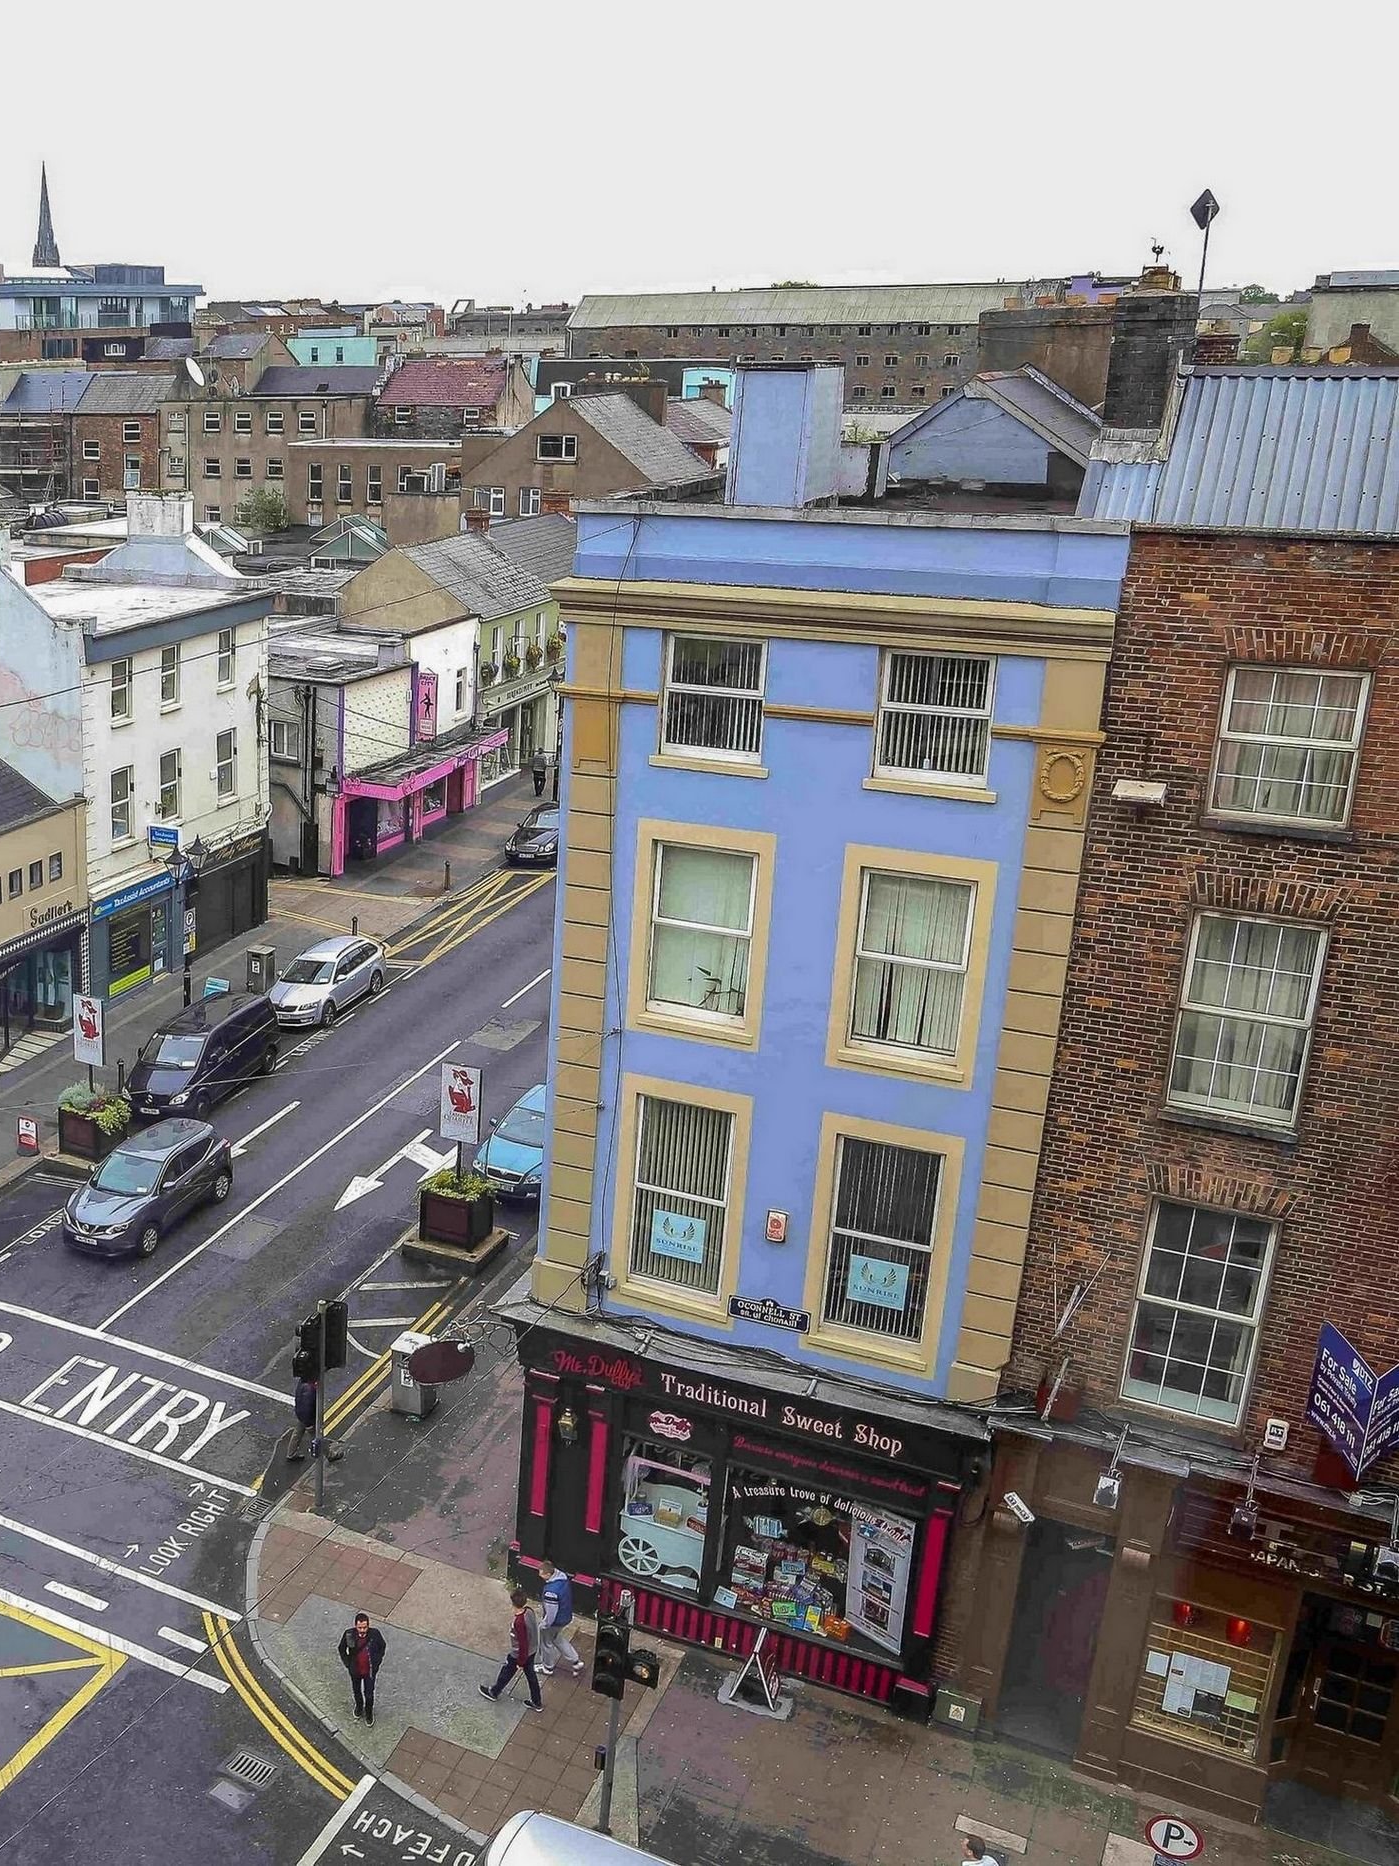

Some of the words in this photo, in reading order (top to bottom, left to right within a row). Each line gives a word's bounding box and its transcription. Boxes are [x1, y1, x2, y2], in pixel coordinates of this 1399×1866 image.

[656, 1238, 699, 1253] SUNRISE
[852, 1284, 901, 1300] SUNRISE
[1321, 1347, 1338, 1372] For
[1338, 1366, 1357, 1396] Sale
[18, 1354, 252, 1462] ENTRY
[660, 1372, 767, 1418] Traditional
[782, 1406, 843, 1439] Sweet
[853, 1423, 903, 1458] Shop
[1314, 1392, 1331, 1417] 061
[1331, 1412, 1346, 1435] 418
[1346, 1430, 1356, 1449] 111
[732, 1485, 742, 1500] A
[743, 1485, 786, 1497] treasure
[790, 1486, 816, 1502] trove
[819, 1493, 832, 1506] of
[833, 1497, 877, 1526] delicious
[138, 1535, 190, 1577] LOOK
[176, 1488, 231, 1542] RIGHT
[1162, 1822, 1185, 1849] P
